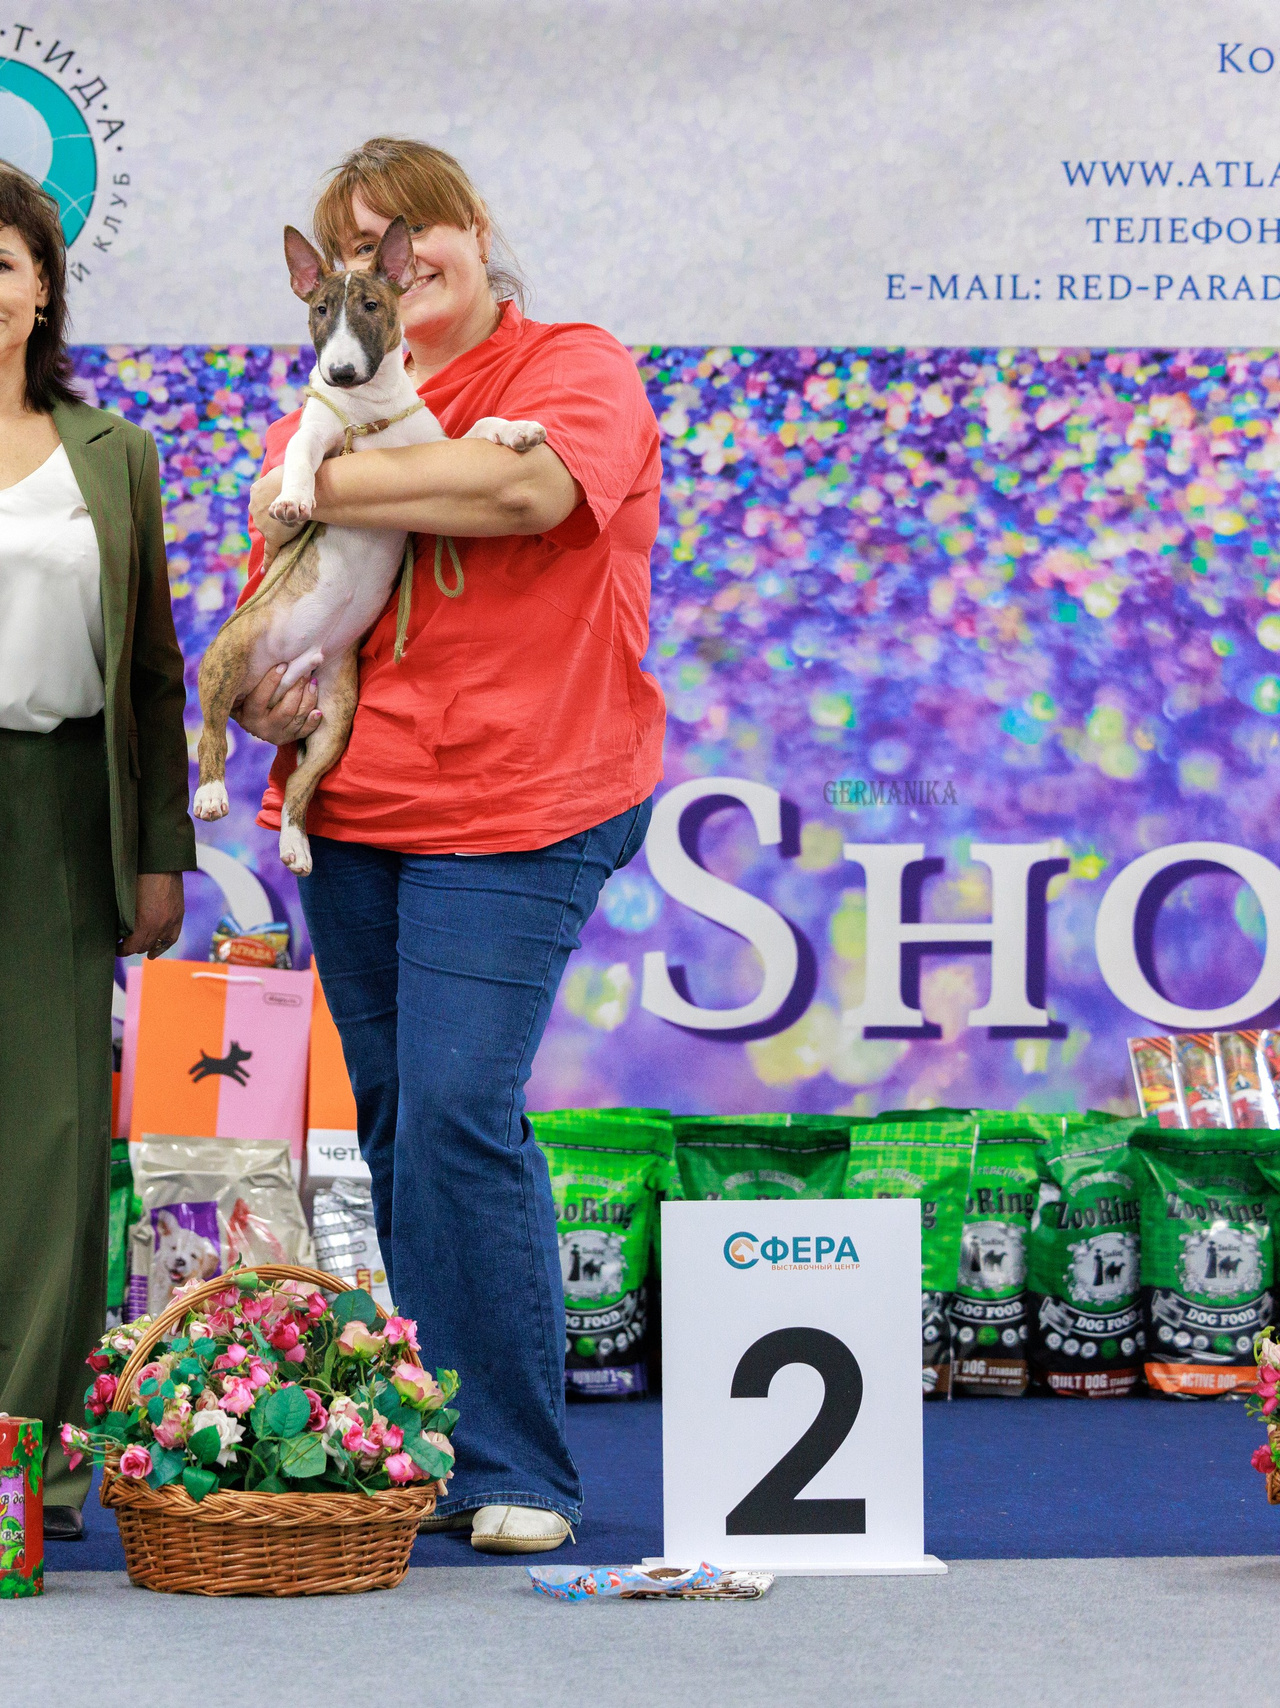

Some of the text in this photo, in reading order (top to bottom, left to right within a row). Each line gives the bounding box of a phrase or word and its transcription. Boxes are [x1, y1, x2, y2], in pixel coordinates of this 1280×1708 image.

[93, 173, 131, 253] КЛУБ
[886, 274, 1042, 301] E-MAIL:
[318, 1145, 365, 1161] чет
[1166, 1190, 1269, 1227] ZooRing
[723, 1231, 860, 1270] СФЕРА
[771, 1263, 860, 1271] ВЫСТАВОЧНЫЙ ЦЕНТР
[954, 1300, 1023, 1318] DOG FOOD
[1186, 1308, 1257, 1326] DOG FOOD
[583, 1310, 621, 1329] FOOD
[1075, 1309, 1140, 1332] DOG FOOD
[962, 1359, 986, 1375] DOG
[1085, 1373, 1108, 1389] DOG
[1181, 1374, 1237, 1389] ACTIVE DOG
[726, 1326, 867, 1536] 2
